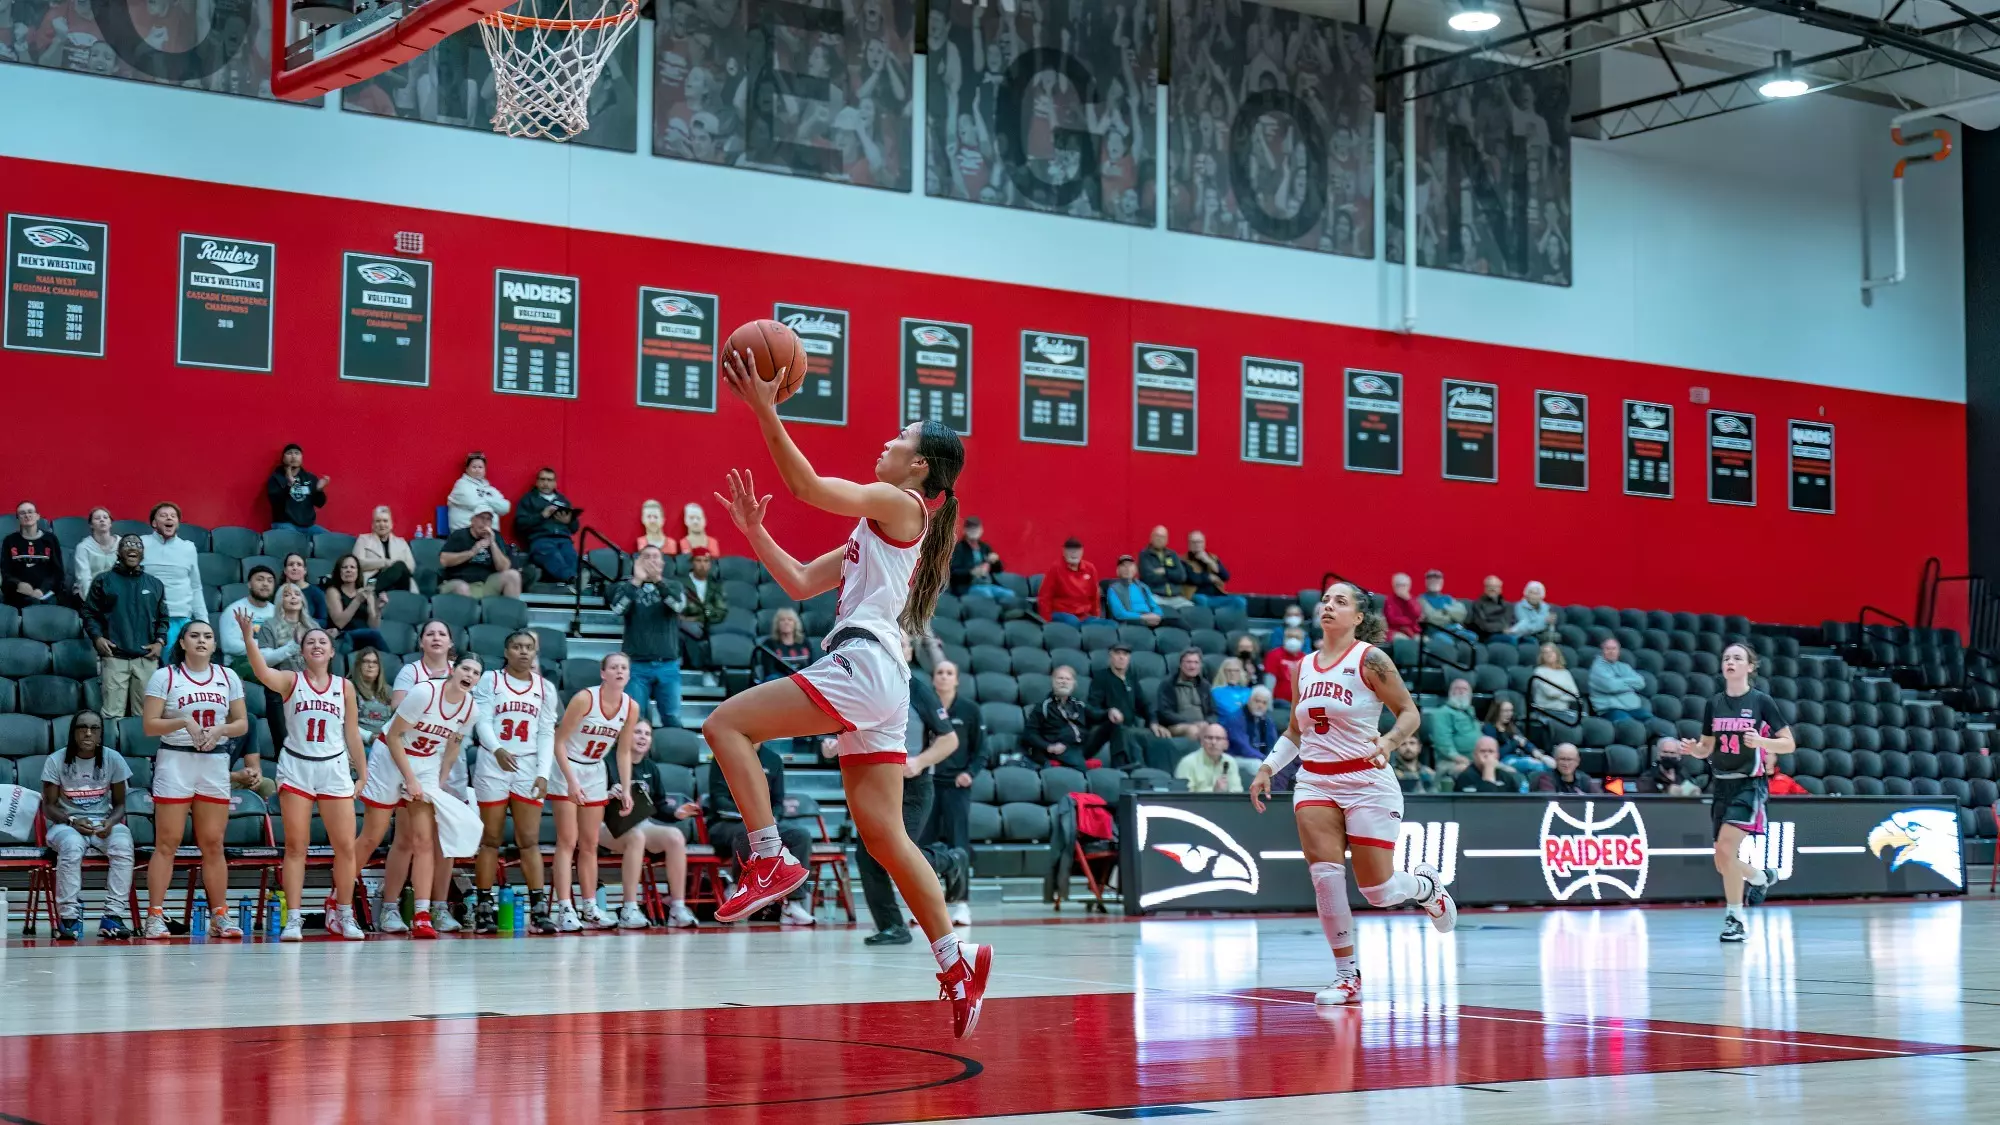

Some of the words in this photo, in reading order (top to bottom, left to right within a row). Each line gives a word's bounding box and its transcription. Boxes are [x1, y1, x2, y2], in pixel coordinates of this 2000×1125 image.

[20, 255, 45, 267] MEN'S
[46, 258, 94, 272] WRESTLING
[197, 240, 260, 266] Raiders
[193, 274, 216, 285] MEN'S
[218, 277, 261, 290] WRESTLING
[502, 280, 573, 305] RAIDERS
[294, 699, 341, 719] RAIDERS
[1307, 706, 1330, 735] 5
[306, 717, 327, 743] 11
[499, 718, 529, 743] 34
[582, 739, 608, 760] 12
[1544, 837, 1644, 874] RAIDERS
